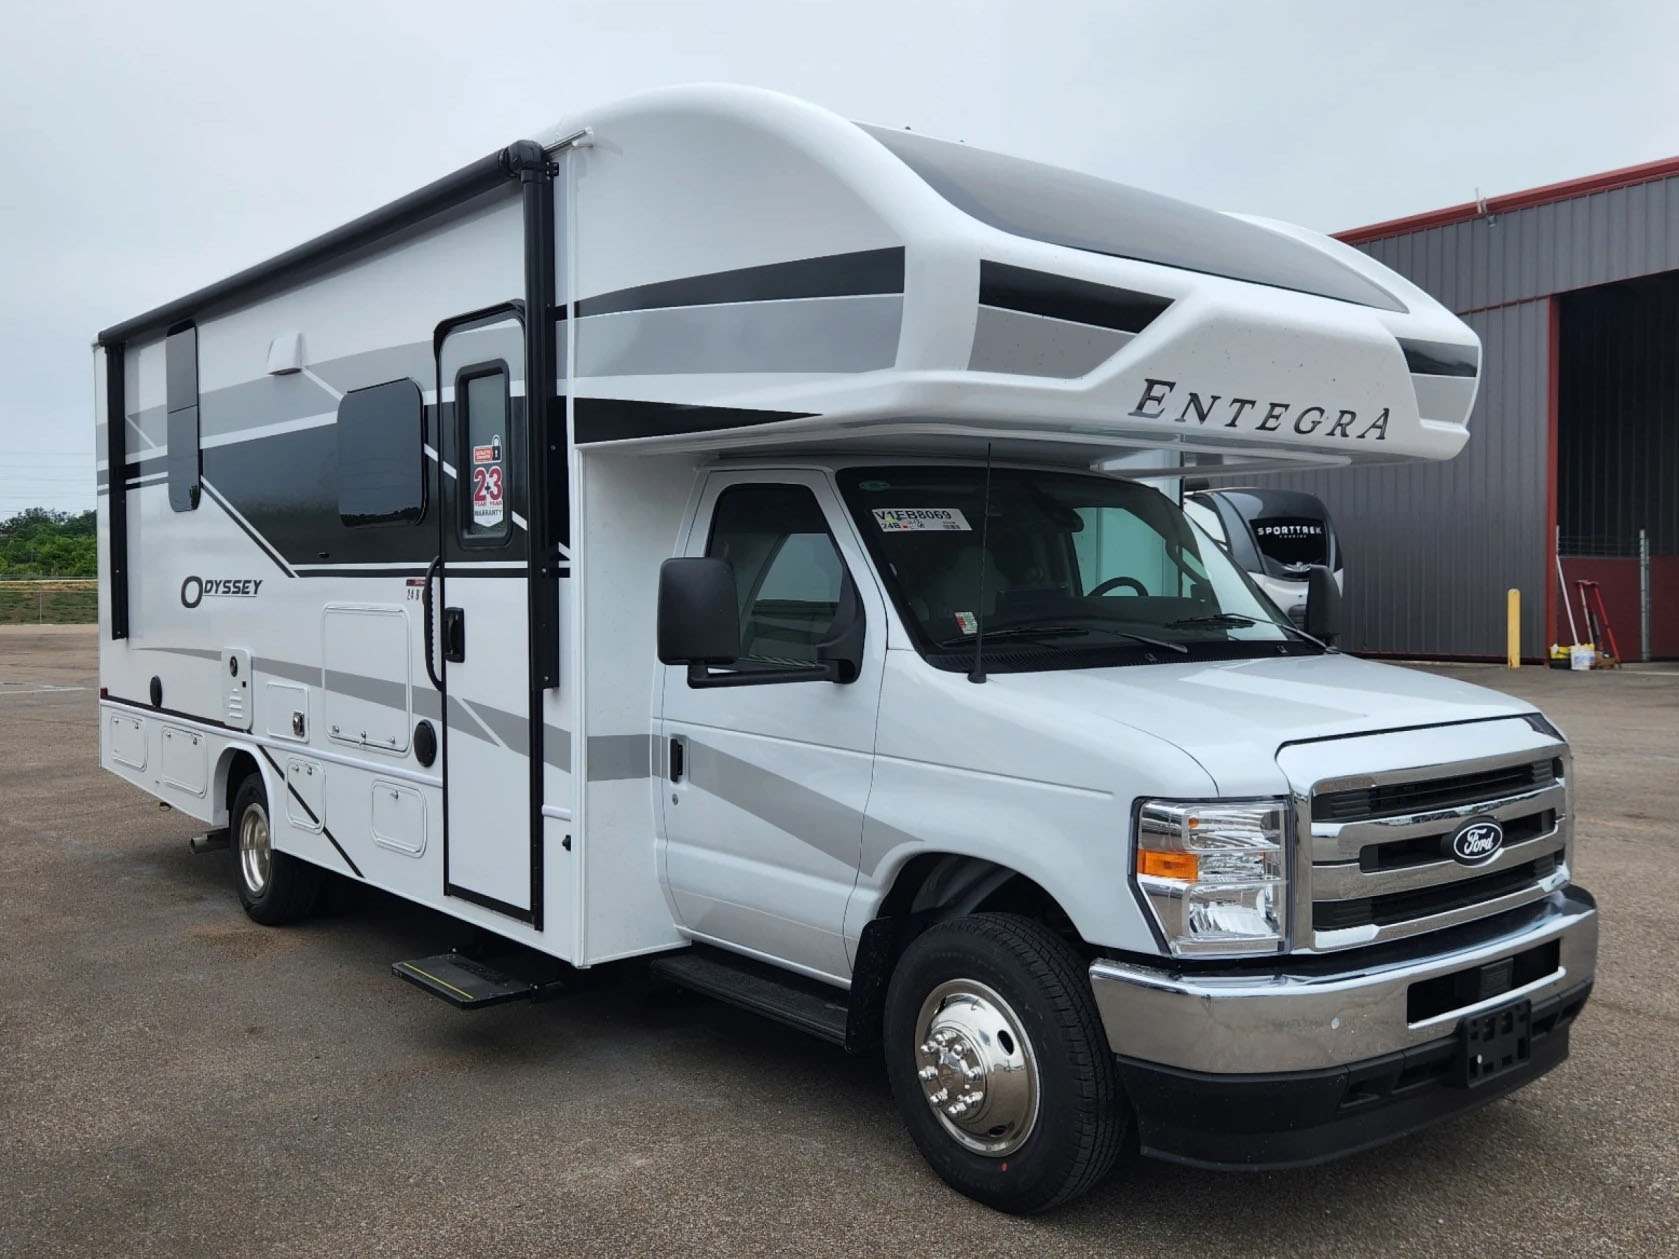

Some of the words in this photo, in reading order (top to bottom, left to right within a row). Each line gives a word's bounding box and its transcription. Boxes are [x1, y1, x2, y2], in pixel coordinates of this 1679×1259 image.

[1128, 378, 1390, 440] ENTEGRA
[475, 509, 502, 517] WARRANTY
[874, 510, 952, 520] V1EB8069
[1257, 526, 1322, 536] SPORTTREK
[181, 575, 263, 608] ODYSSEY
[1464, 828, 1495, 855] Ford
